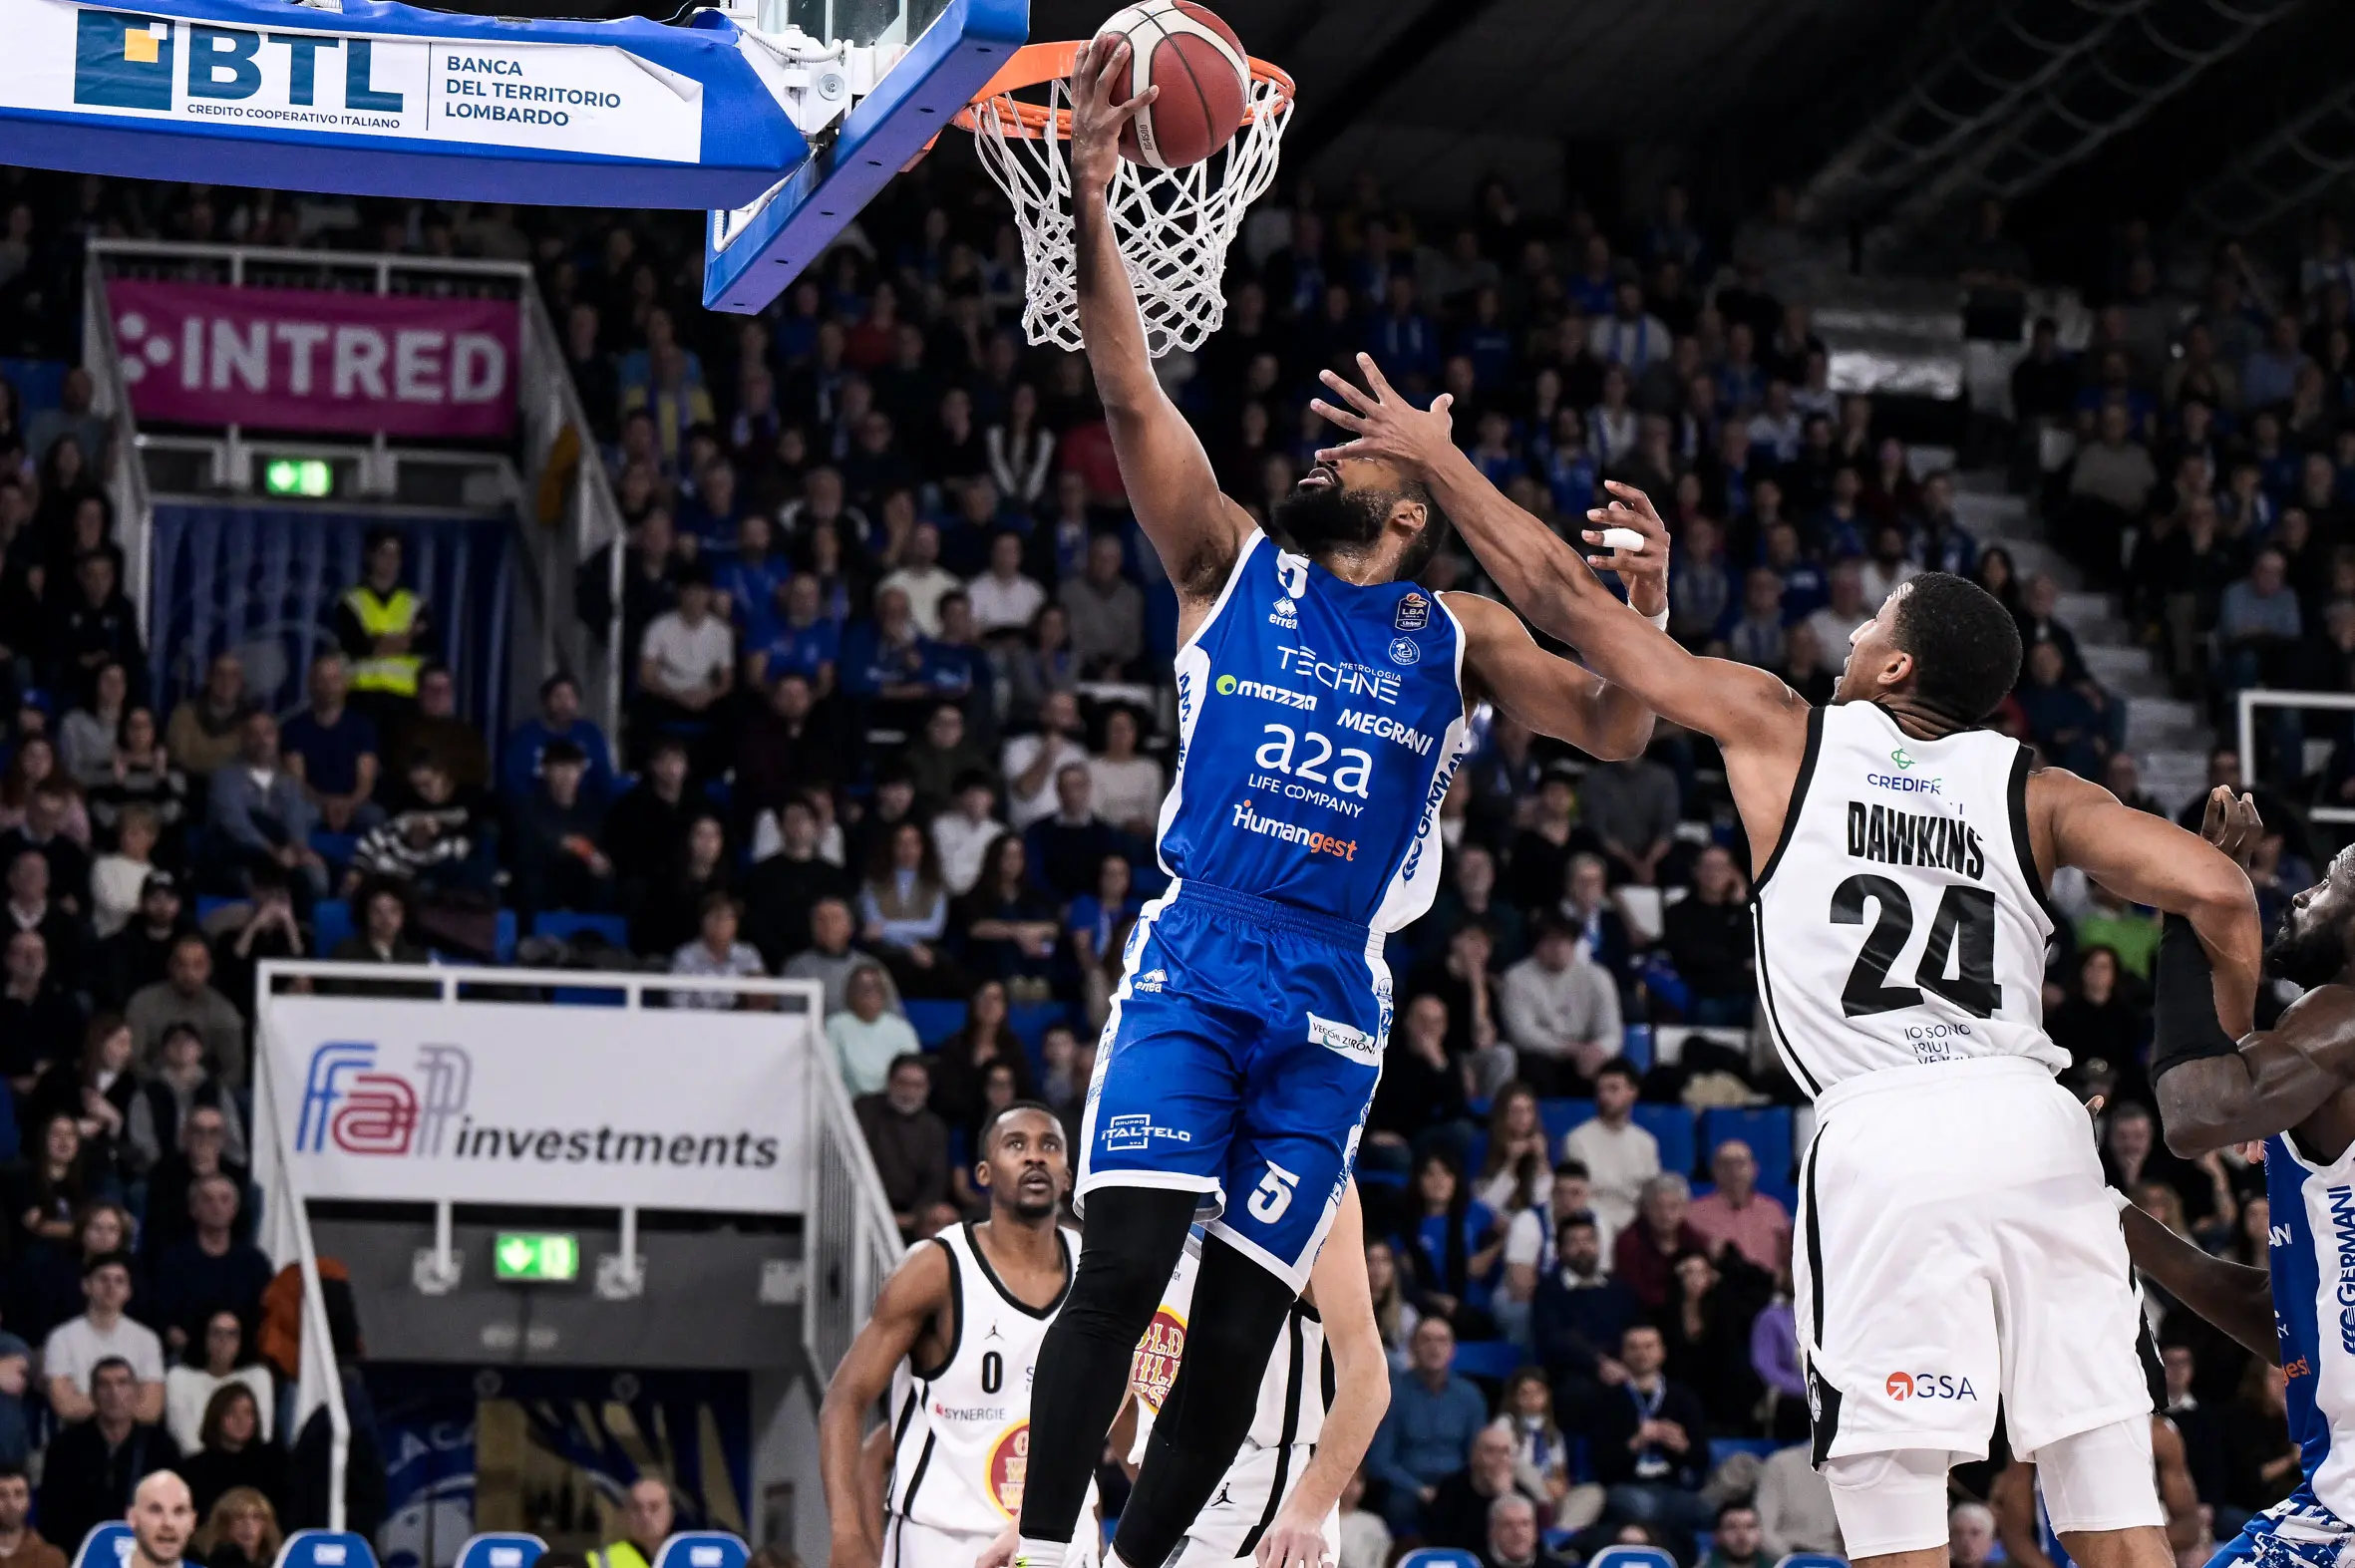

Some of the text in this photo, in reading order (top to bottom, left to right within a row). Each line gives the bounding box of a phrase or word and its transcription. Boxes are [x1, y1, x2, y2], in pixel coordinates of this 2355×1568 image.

[187, 25, 404, 113] BTL
[447, 56, 522, 77] BANCA
[446, 79, 621, 109] DEL TERRITORIO
[446, 102, 569, 127] LOMBARDO
[187, 104, 401, 129] CREDITO COOPERATIVO ITALIANO
[180, 316, 506, 404] INTRED
[1276, 548, 1311, 599] 5
[1340, 662, 1402, 682] METROLOGIA
[1237, 680, 1317, 712] mazza
[1337, 709, 1434, 757] MEGRANI
[1254, 724, 1374, 799] a2a
[1248, 774, 1364, 818] LIFE COMPANY
[1232, 799, 1358, 862] Humangest
[1848, 800, 1985, 881] DAWKINS
[1830, 874, 2002, 1018] 24
[1904, 1024, 1970, 1040] IO SONO
[1912, 1042, 1949, 1054] FRIUI
[455, 1115, 780, 1168] investments
[1246, 1159, 1300, 1225] 5
[982, 1351, 1003, 1395] 0
[1916, 1373, 1977, 1402] GSA
[944, 1407, 1006, 1421] SYNERGIE
